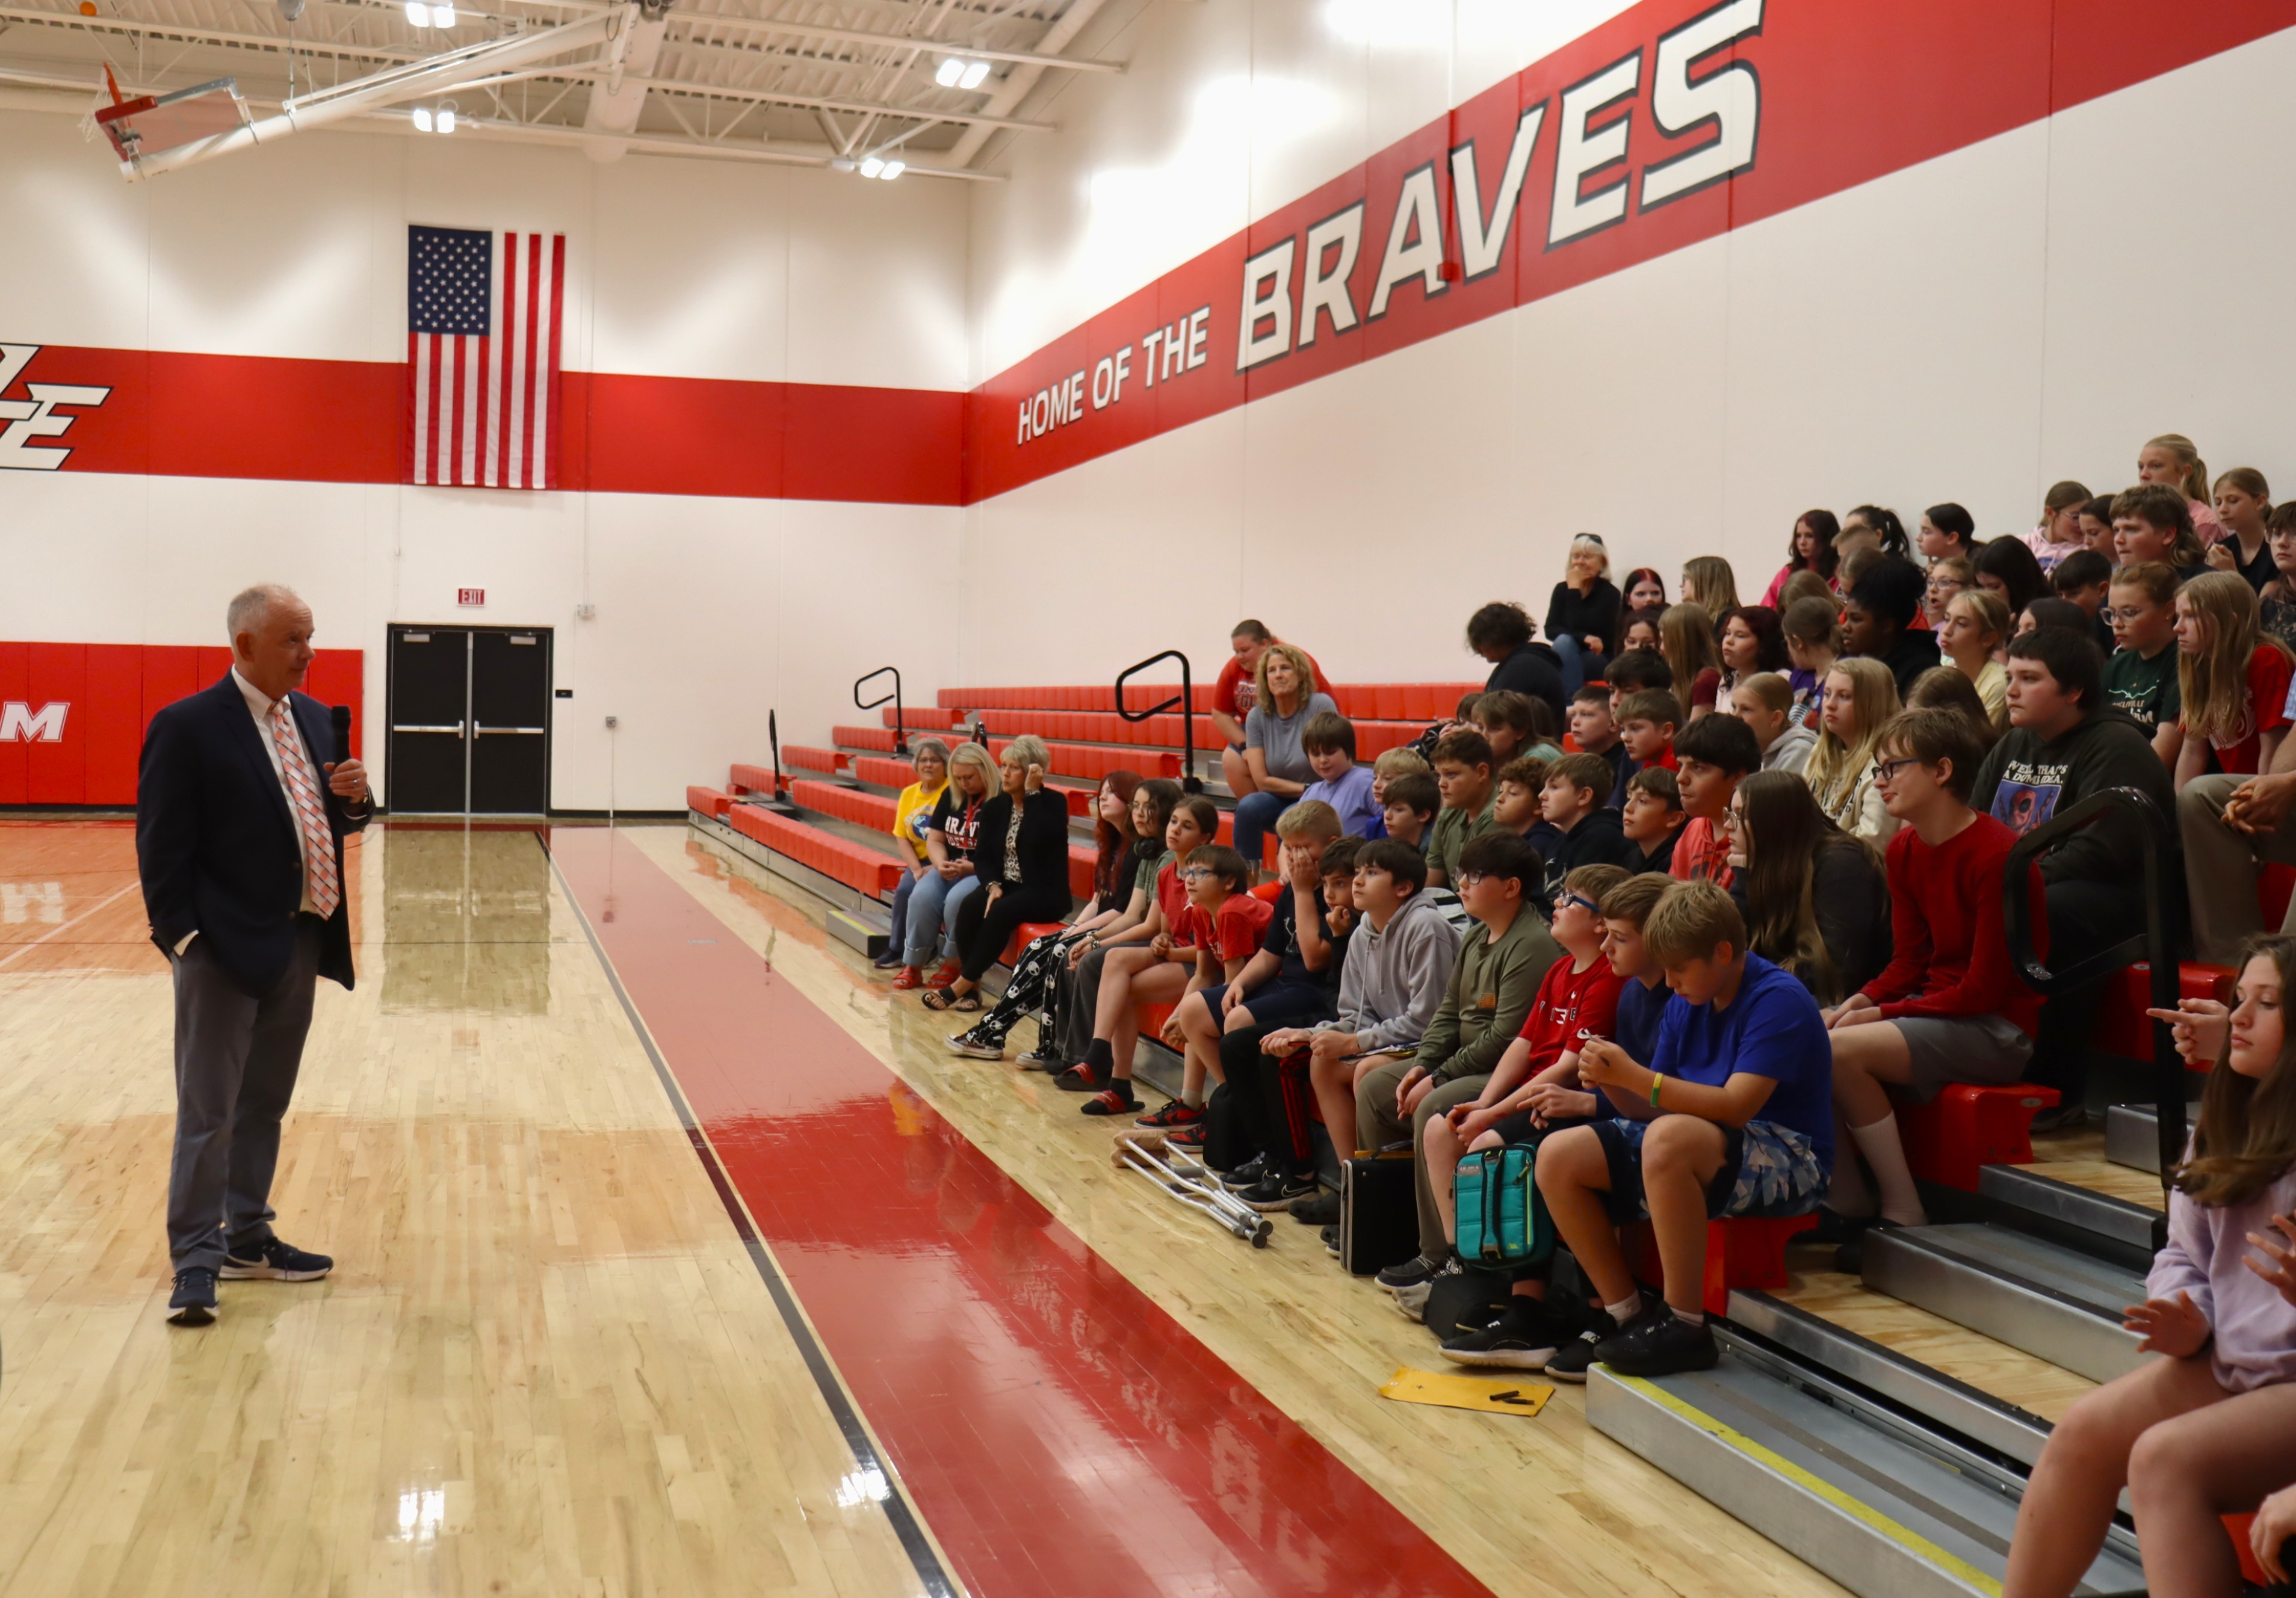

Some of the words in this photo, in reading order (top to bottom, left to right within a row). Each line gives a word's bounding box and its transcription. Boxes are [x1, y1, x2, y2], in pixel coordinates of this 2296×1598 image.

[1017, 369, 1085, 446] HOME
[1092, 344, 1132, 412] OF
[1142, 303, 1211, 390] THE
[1234, 0, 1767, 376] BRAVES
[462, 589, 483, 605] EXIT
[945, 815, 980, 838] BRAV
